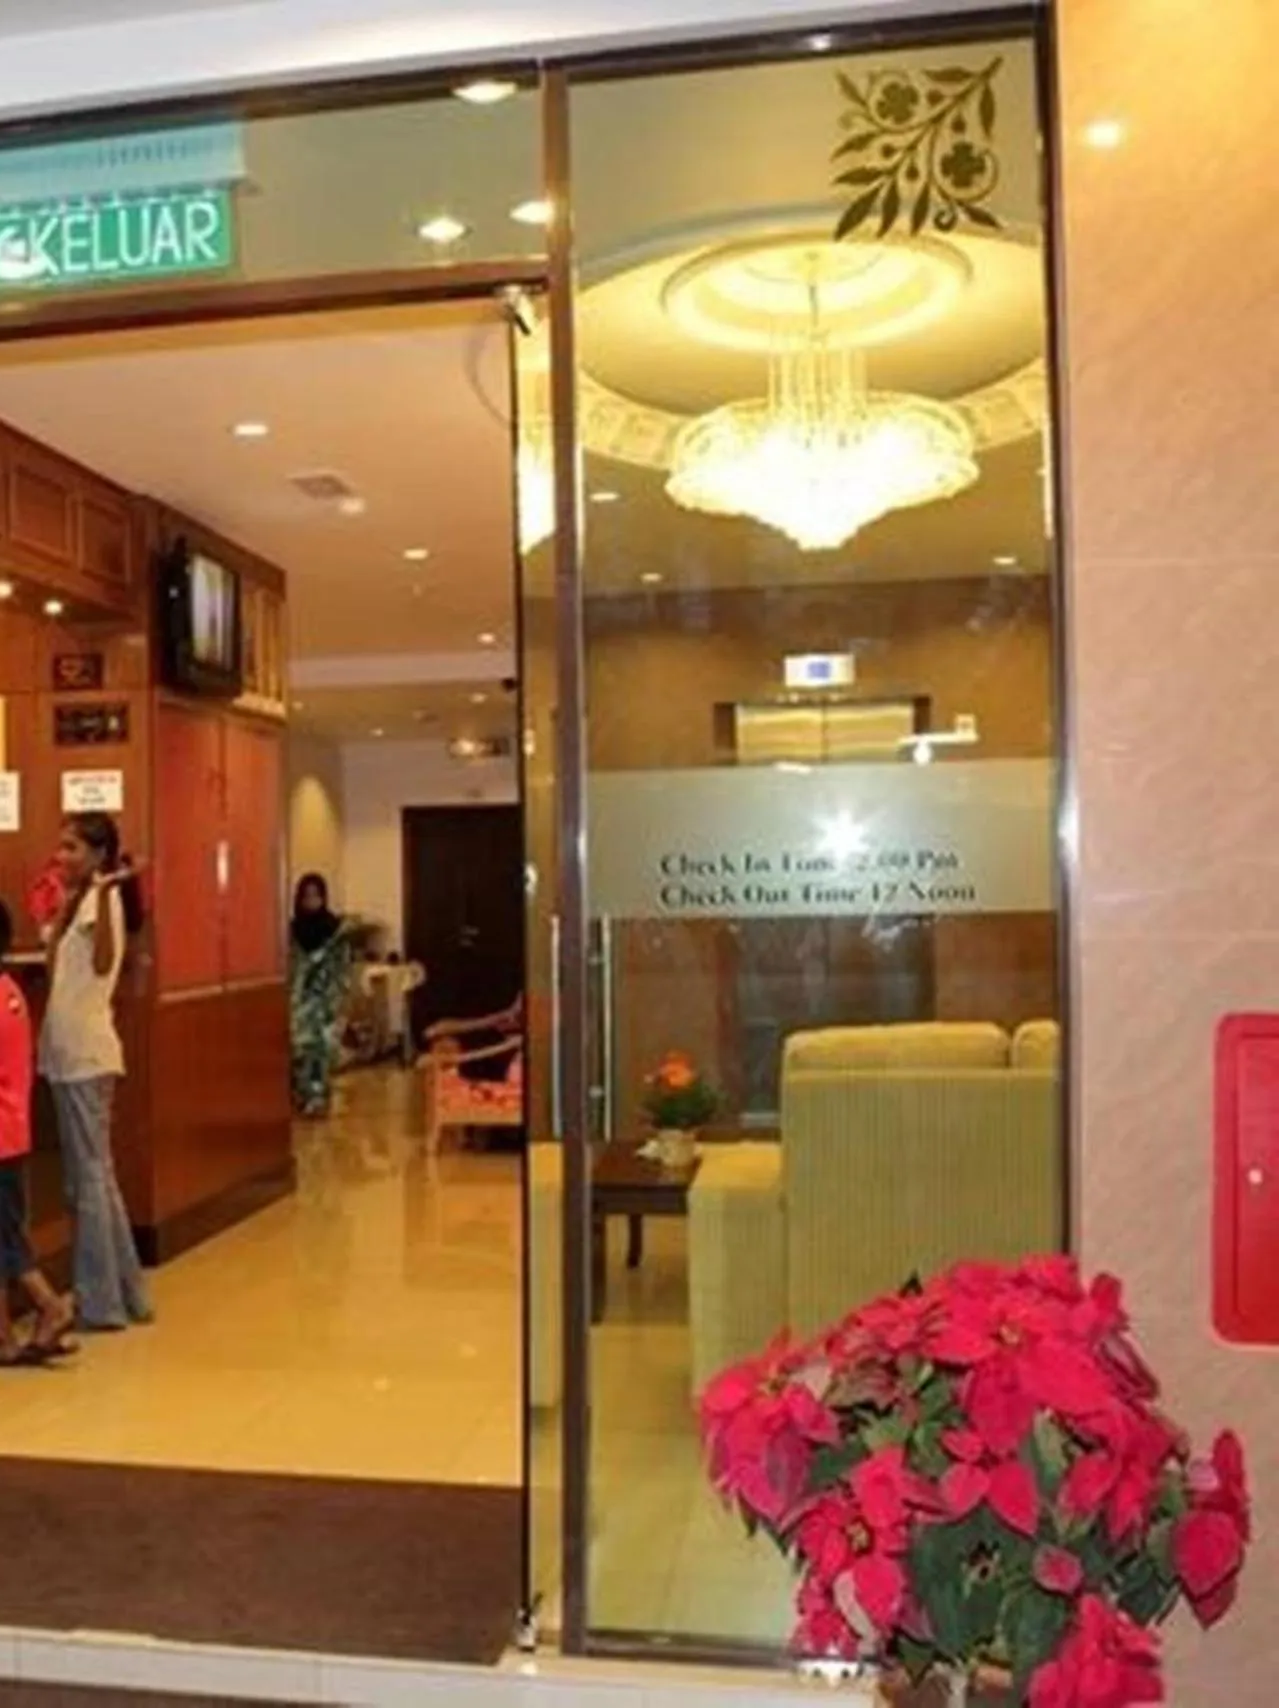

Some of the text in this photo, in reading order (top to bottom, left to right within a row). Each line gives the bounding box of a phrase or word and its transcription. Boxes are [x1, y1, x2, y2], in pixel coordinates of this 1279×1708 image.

[28, 199, 219, 276] KELUAR
[661, 853, 735, 874] Check
[744, 852, 771, 872] In
[661, 884, 736, 904] Check
[743, 884, 789, 902] Out
[909, 880, 976, 900] Noon
